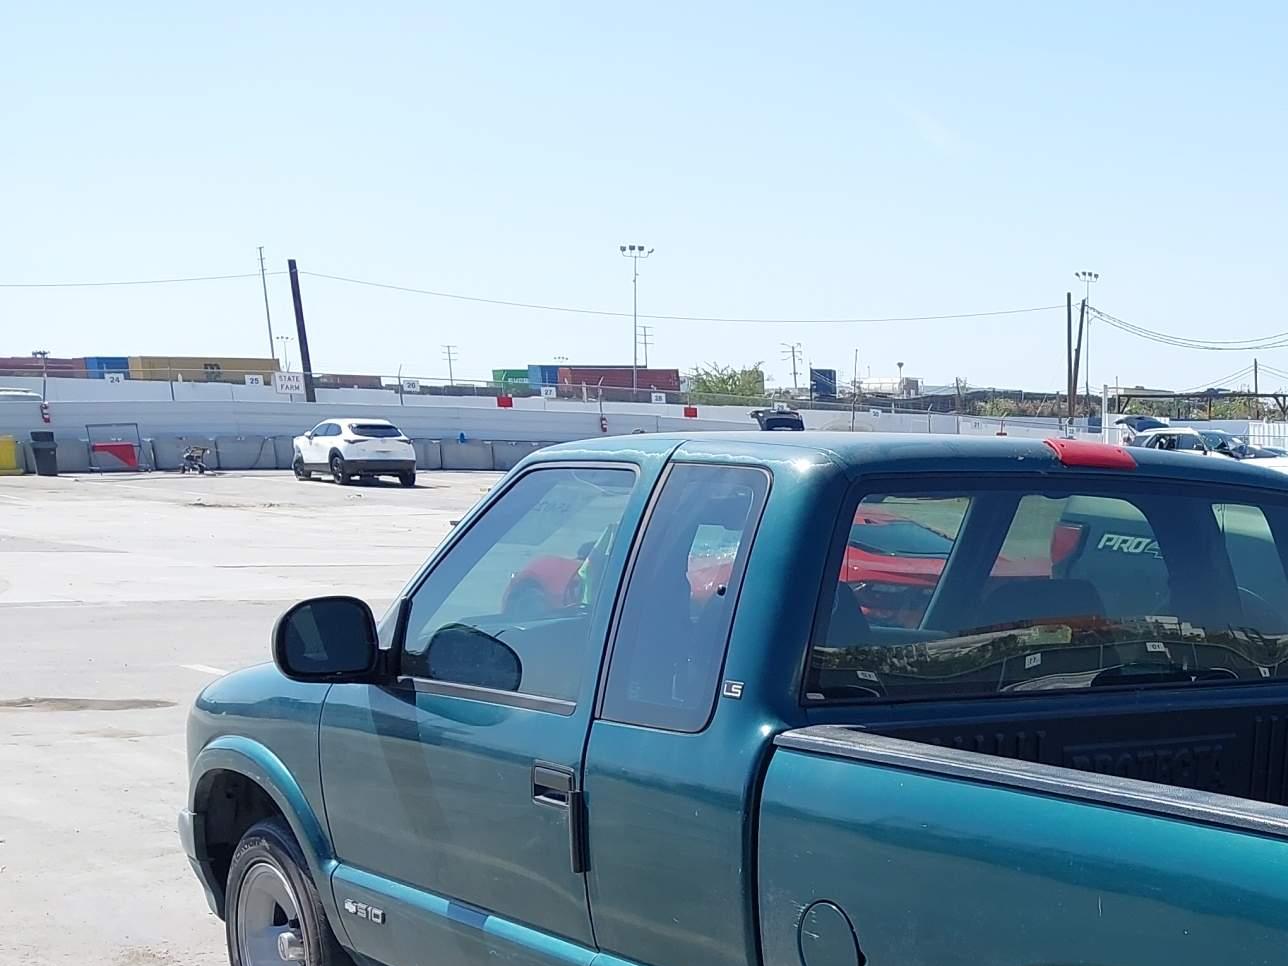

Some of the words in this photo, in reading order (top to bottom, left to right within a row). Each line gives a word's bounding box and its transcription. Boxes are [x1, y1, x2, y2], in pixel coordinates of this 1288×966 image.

[280, 383, 300, 391] FARM
[723, 679, 745, 698] LS
[356, 901, 385, 924] S10
